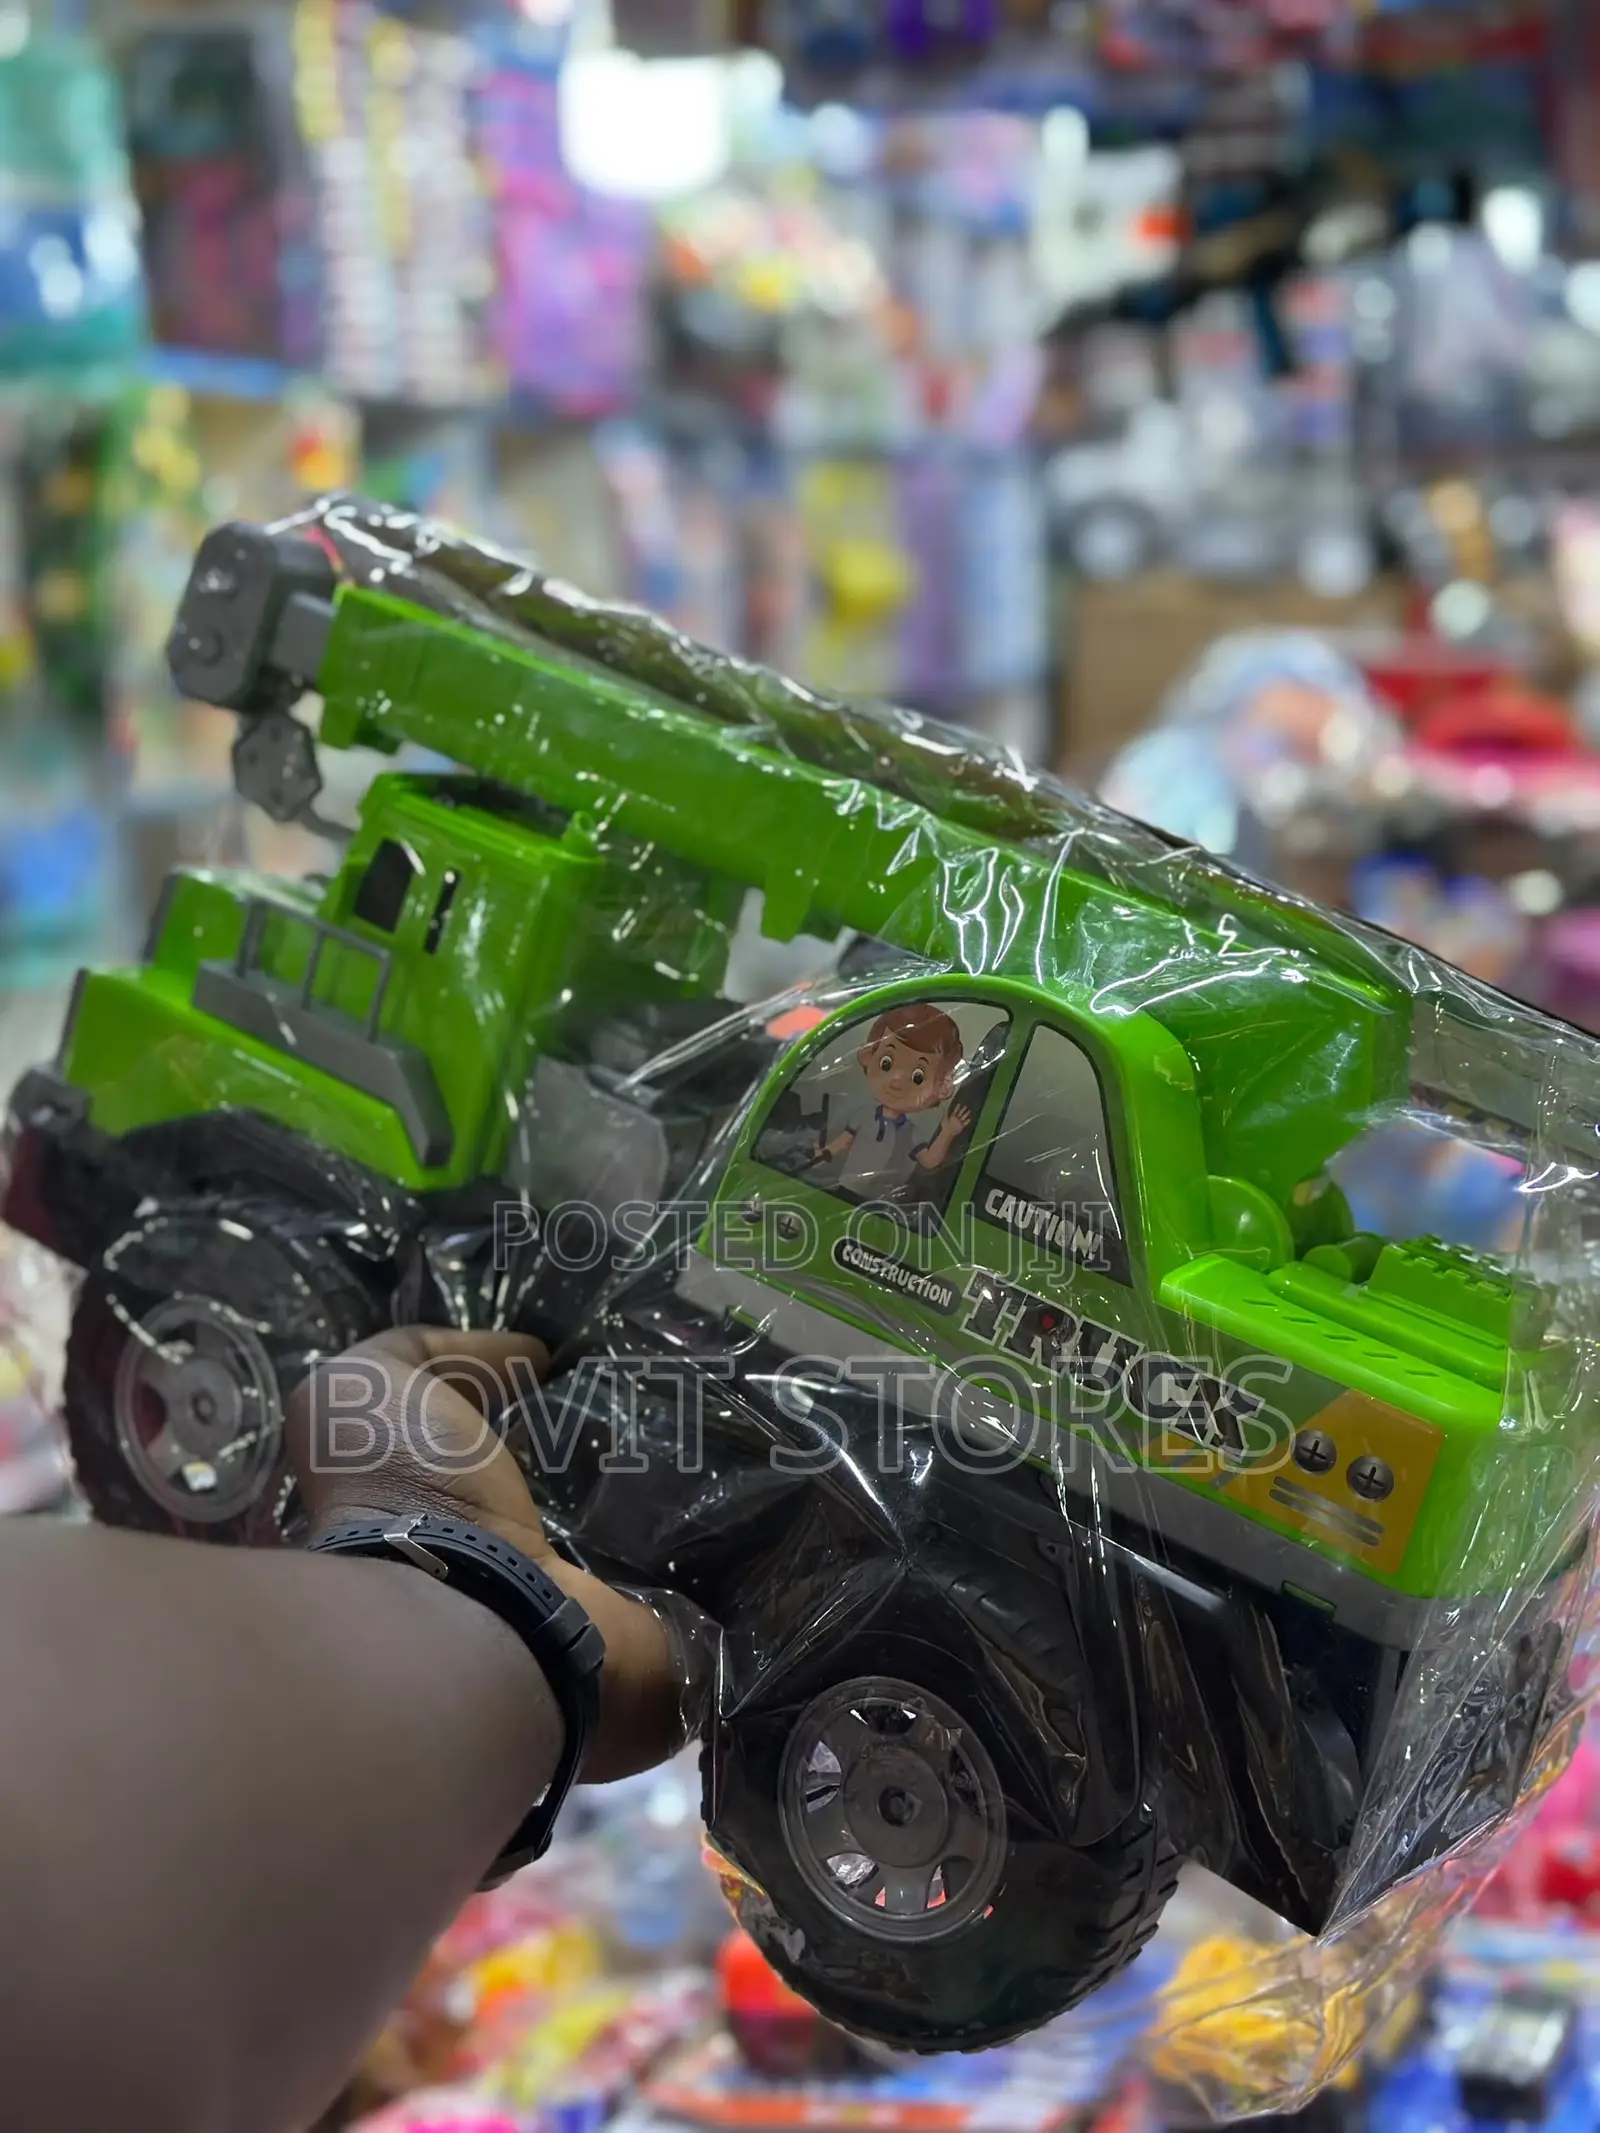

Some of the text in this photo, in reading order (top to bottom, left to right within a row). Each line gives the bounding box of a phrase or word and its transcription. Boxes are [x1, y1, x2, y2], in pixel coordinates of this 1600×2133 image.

[984, 1188, 1104, 1261] CAUTION!
[841, 1244, 953, 1308] CONSTRUCTION
[959, 1268, 1266, 1464] TRUCK
